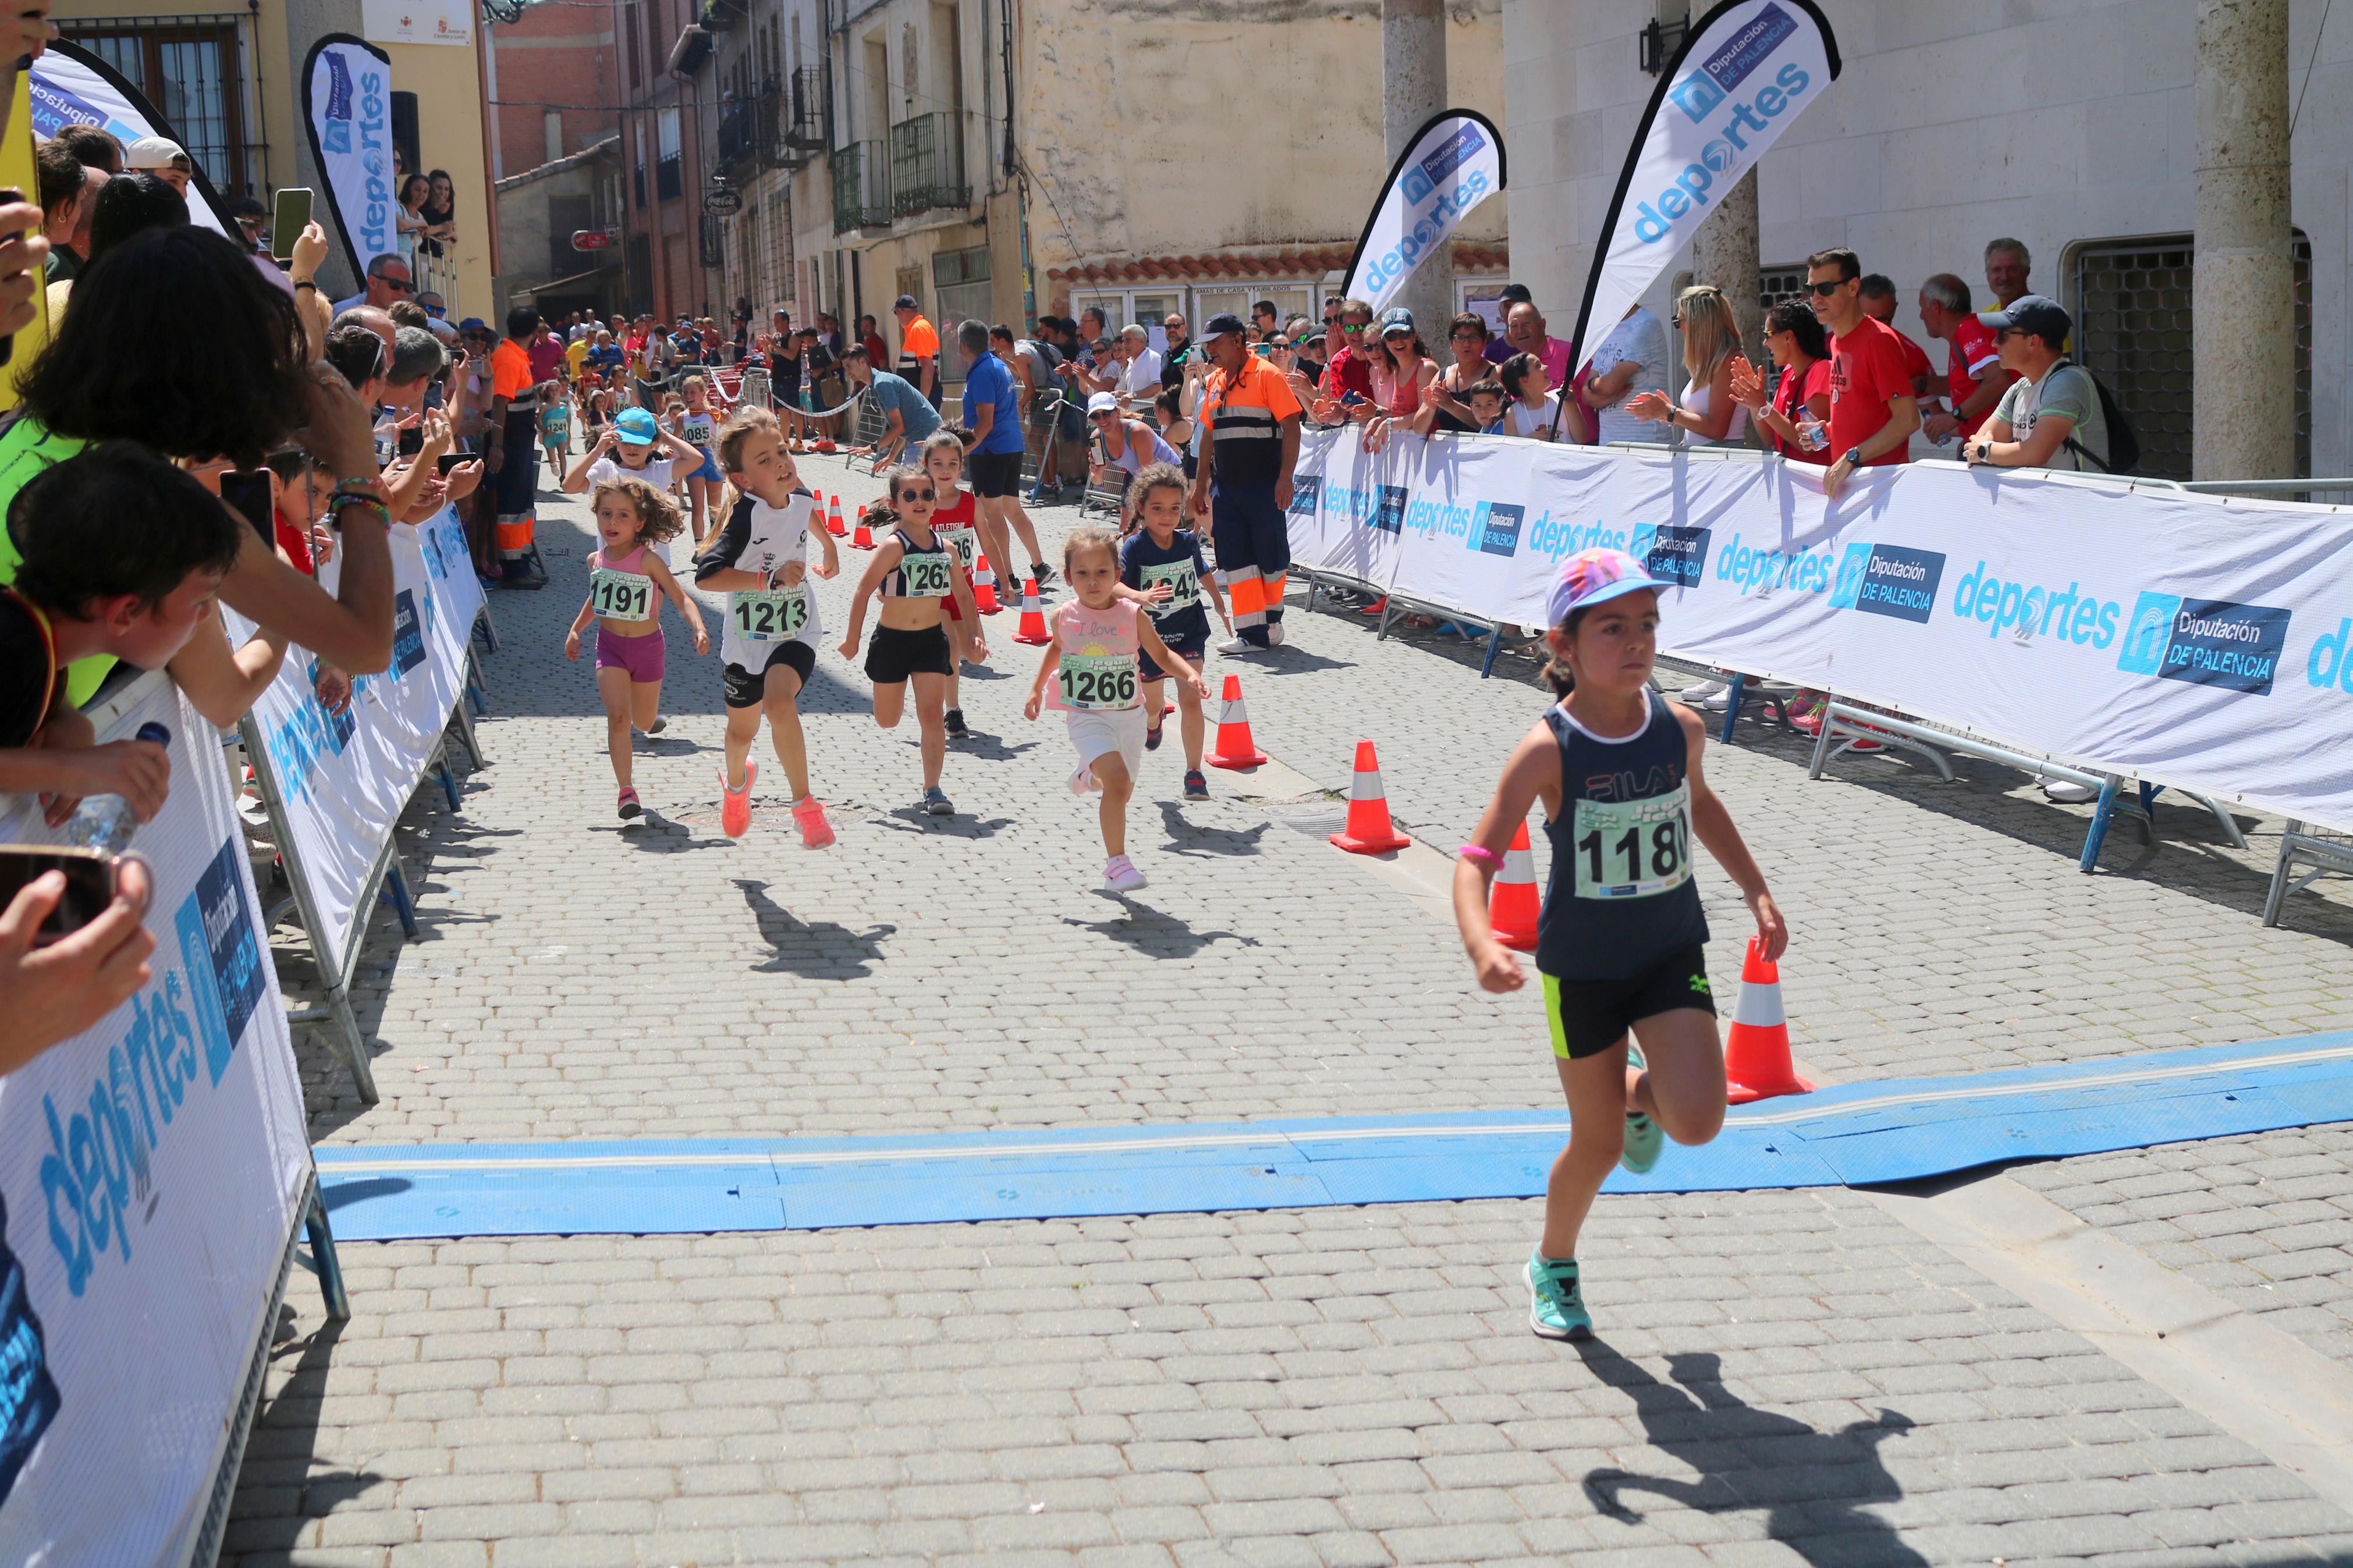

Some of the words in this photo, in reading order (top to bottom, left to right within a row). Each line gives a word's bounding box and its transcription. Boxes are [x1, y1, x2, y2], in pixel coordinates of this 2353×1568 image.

[1708, 19, 1768, 75] Diputación
[1720, 67, 1739, 87] DE
[1738, 18, 1791, 70] PALENCIA
[359, 72, 389, 252] deportes
[1425, 134, 1467, 172] Diputación
[1444, 136, 1482, 171] PALENCIA
[1635, 62, 1809, 244] deportes
[1366, 170, 1488, 293] deportes
[548, 423, 567, 432] 1241
[1323, 478, 1370, 520] deportes
[1406, 491, 1470, 538] deportes
[1488, 511, 1515, 527] Diputación
[1484, 531, 1492, 543] DE
[1491, 531, 1516, 547] PALENCIA
[1653, 534, 1697, 554] Diputación
[1651, 556, 1663, 573] DE
[1663, 557, 1701, 578] PALENCIA
[1716, 532, 1834, 595] deportes
[1869, 555, 1926, 581] Diputación
[591, 579, 647, 614] 1191
[1861, 581, 1881, 602] DE
[1879, 584, 1931, 611] PALENCIA
[1953, 560, 2121, 650] deportes
[735, 599, 808, 632] 1213
[1078, 623, 1086, 637] I
[1088, 621, 1118, 637] love
[2178, 610, 2261, 643] Diputación
[2168, 644, 2193, 666] DE
[2192, 647, 2271, 680] PALENCIA
[1060, 669, 1135, 702] 1266
[1585, 765, 1668, 802] FILA
[41, 968, 198, 1298] deportes
